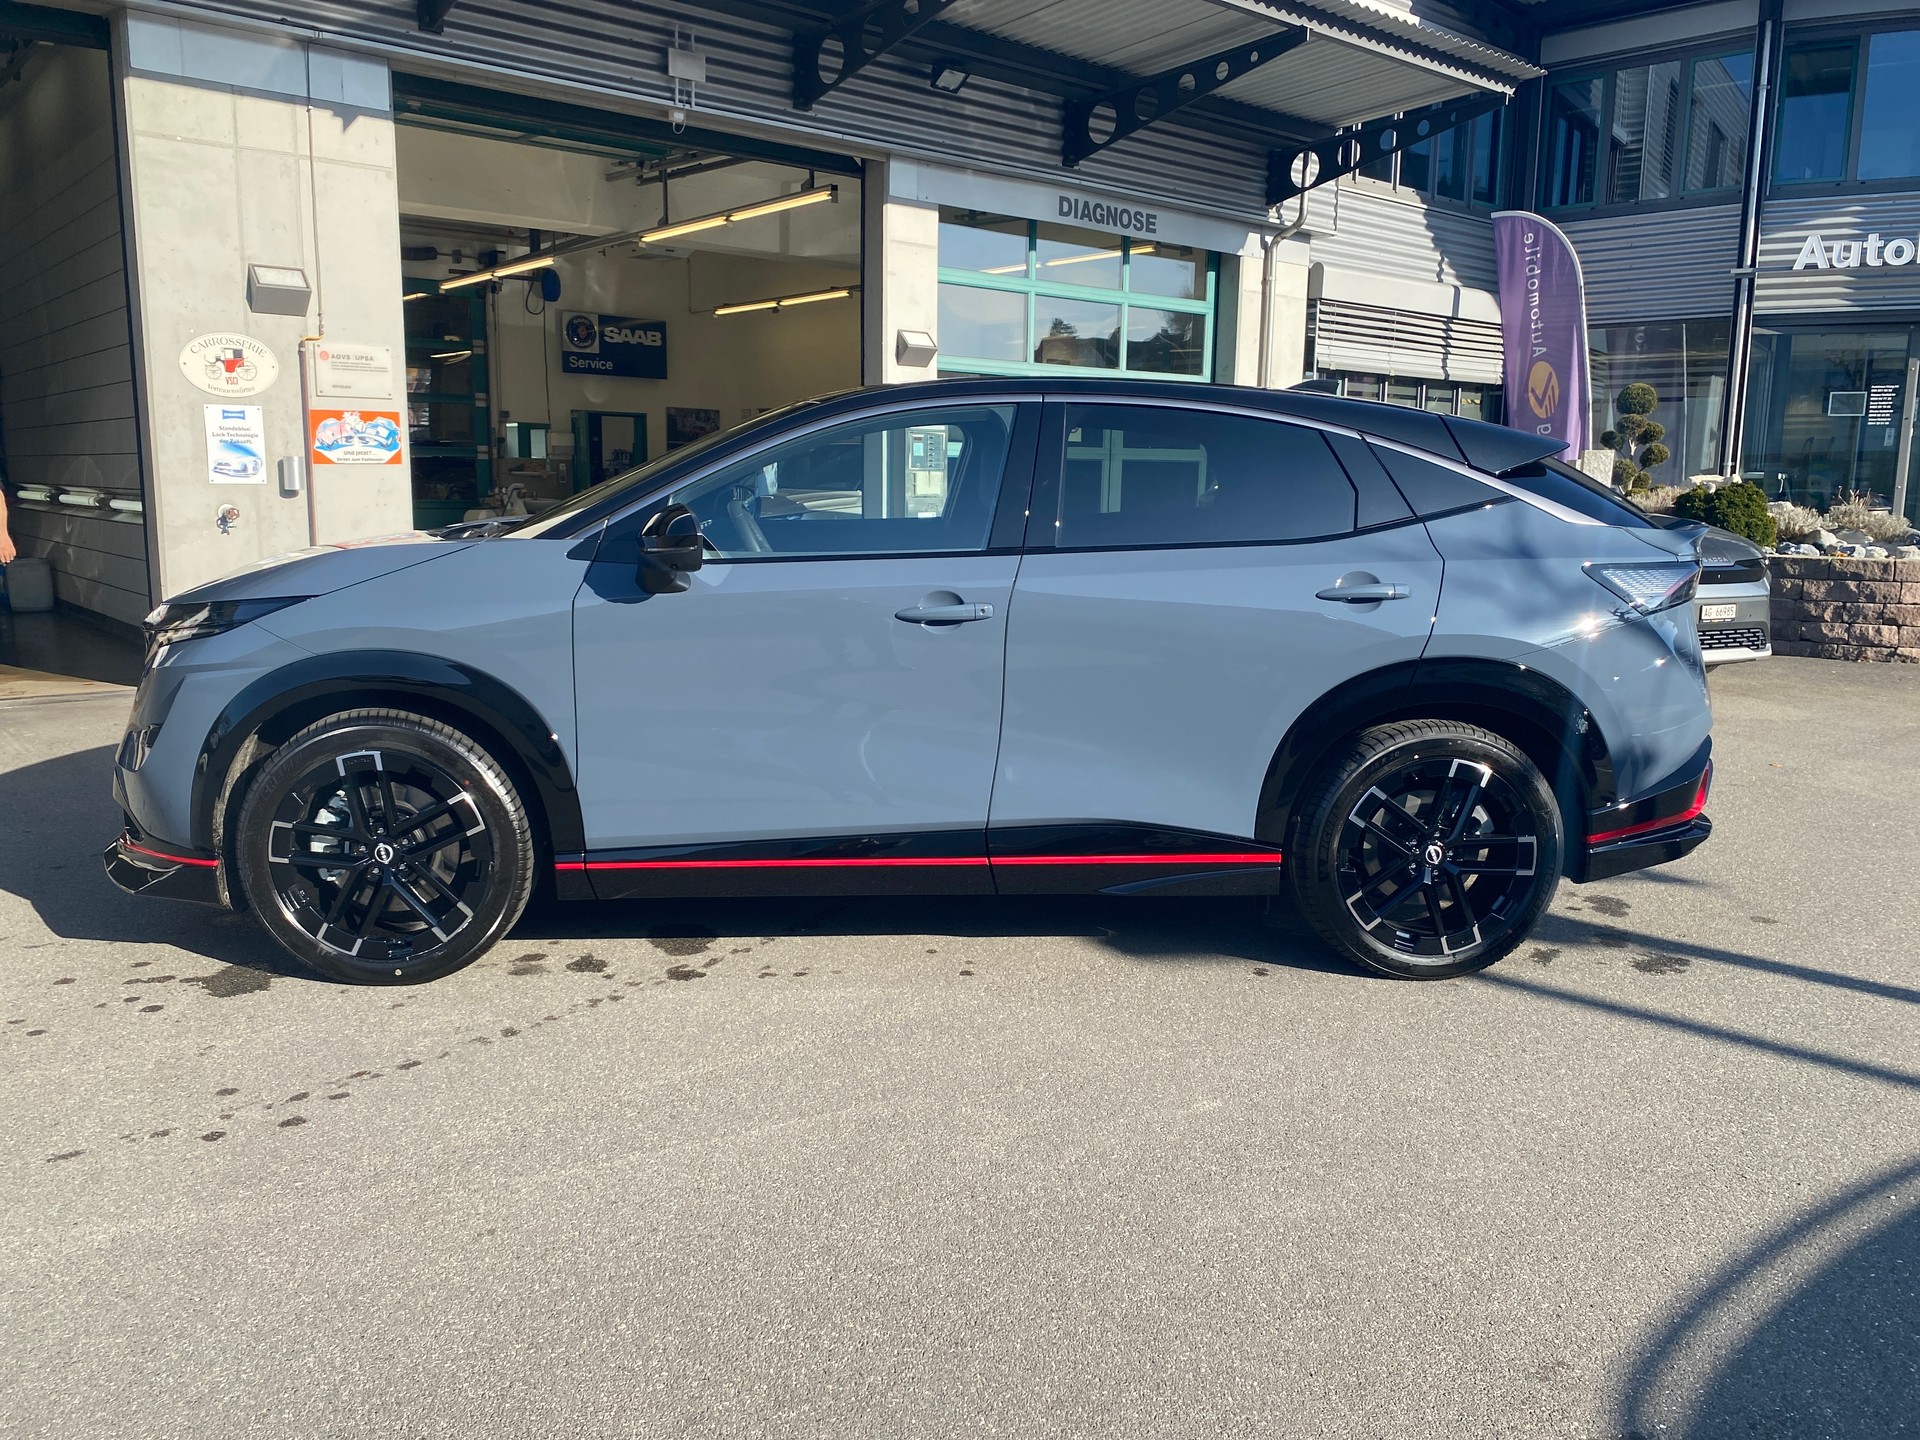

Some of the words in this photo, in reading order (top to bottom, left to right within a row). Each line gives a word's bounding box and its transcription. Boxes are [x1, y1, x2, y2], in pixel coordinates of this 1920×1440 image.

[1058, 195, 1157, 234] DIAGNOSE
[1792, 233, 1920, 270] Auto
[190, 336, 267, 358] CARROSSERIE
[603, 326, 662, 347] SAAB
[569, 356, 613, 370] Service
[225, 376, 239, 385] VSCI
[1704, 607, 1713, 617] AG
